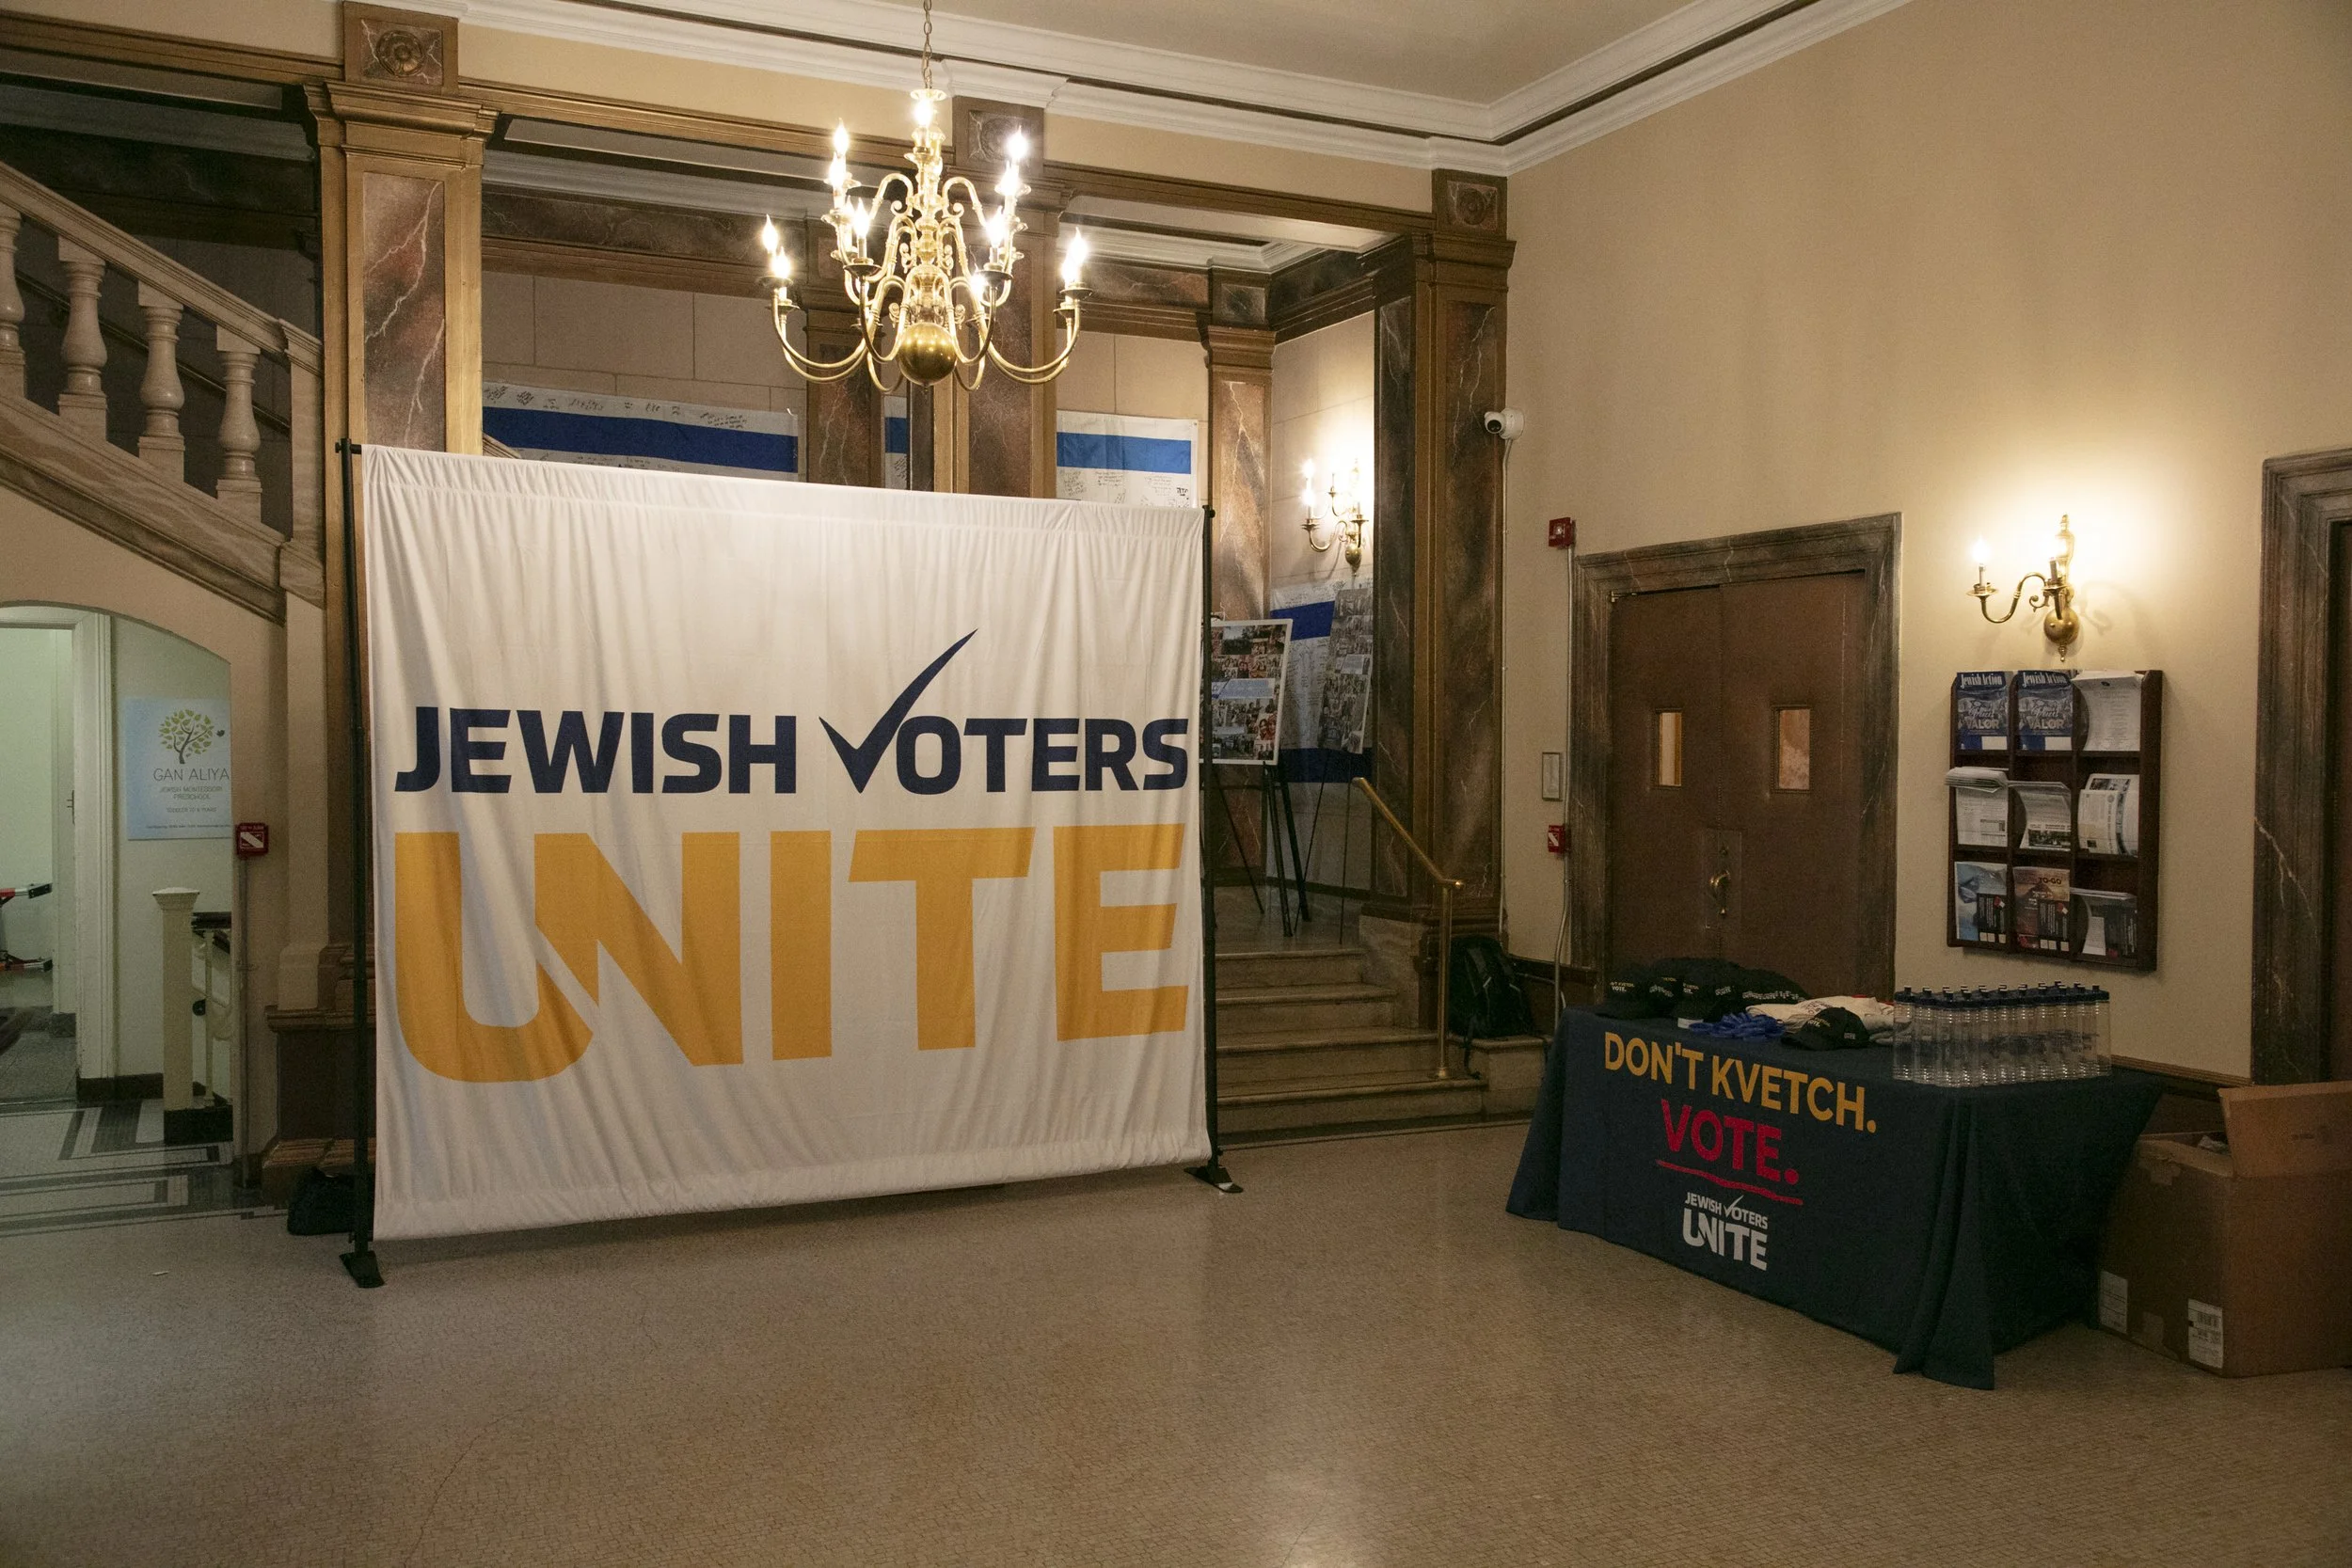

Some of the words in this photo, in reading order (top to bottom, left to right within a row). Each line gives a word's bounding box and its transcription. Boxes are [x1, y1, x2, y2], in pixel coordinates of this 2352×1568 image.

[394, 706, 797, 794] JEWISH
[818, 627, 1189, 795] VOTERS
[152, 768, 183, 782] GAN
[188, 768, 230, 782] ALIYA
[394, 823, 1189, 1083] UNITE
[1605, 1032, 1704, 1090] DON'T
[1711, 1054, 1877, 1133] KVETCH.
[1661, 1099, 1799, 1185] VOTE.
[1682, 1207, 1768, 1272] UNITE
[1684, 1192, 1723, 1215] JEWISH
[1723, 1195, 1768, 1229] VOTERS
